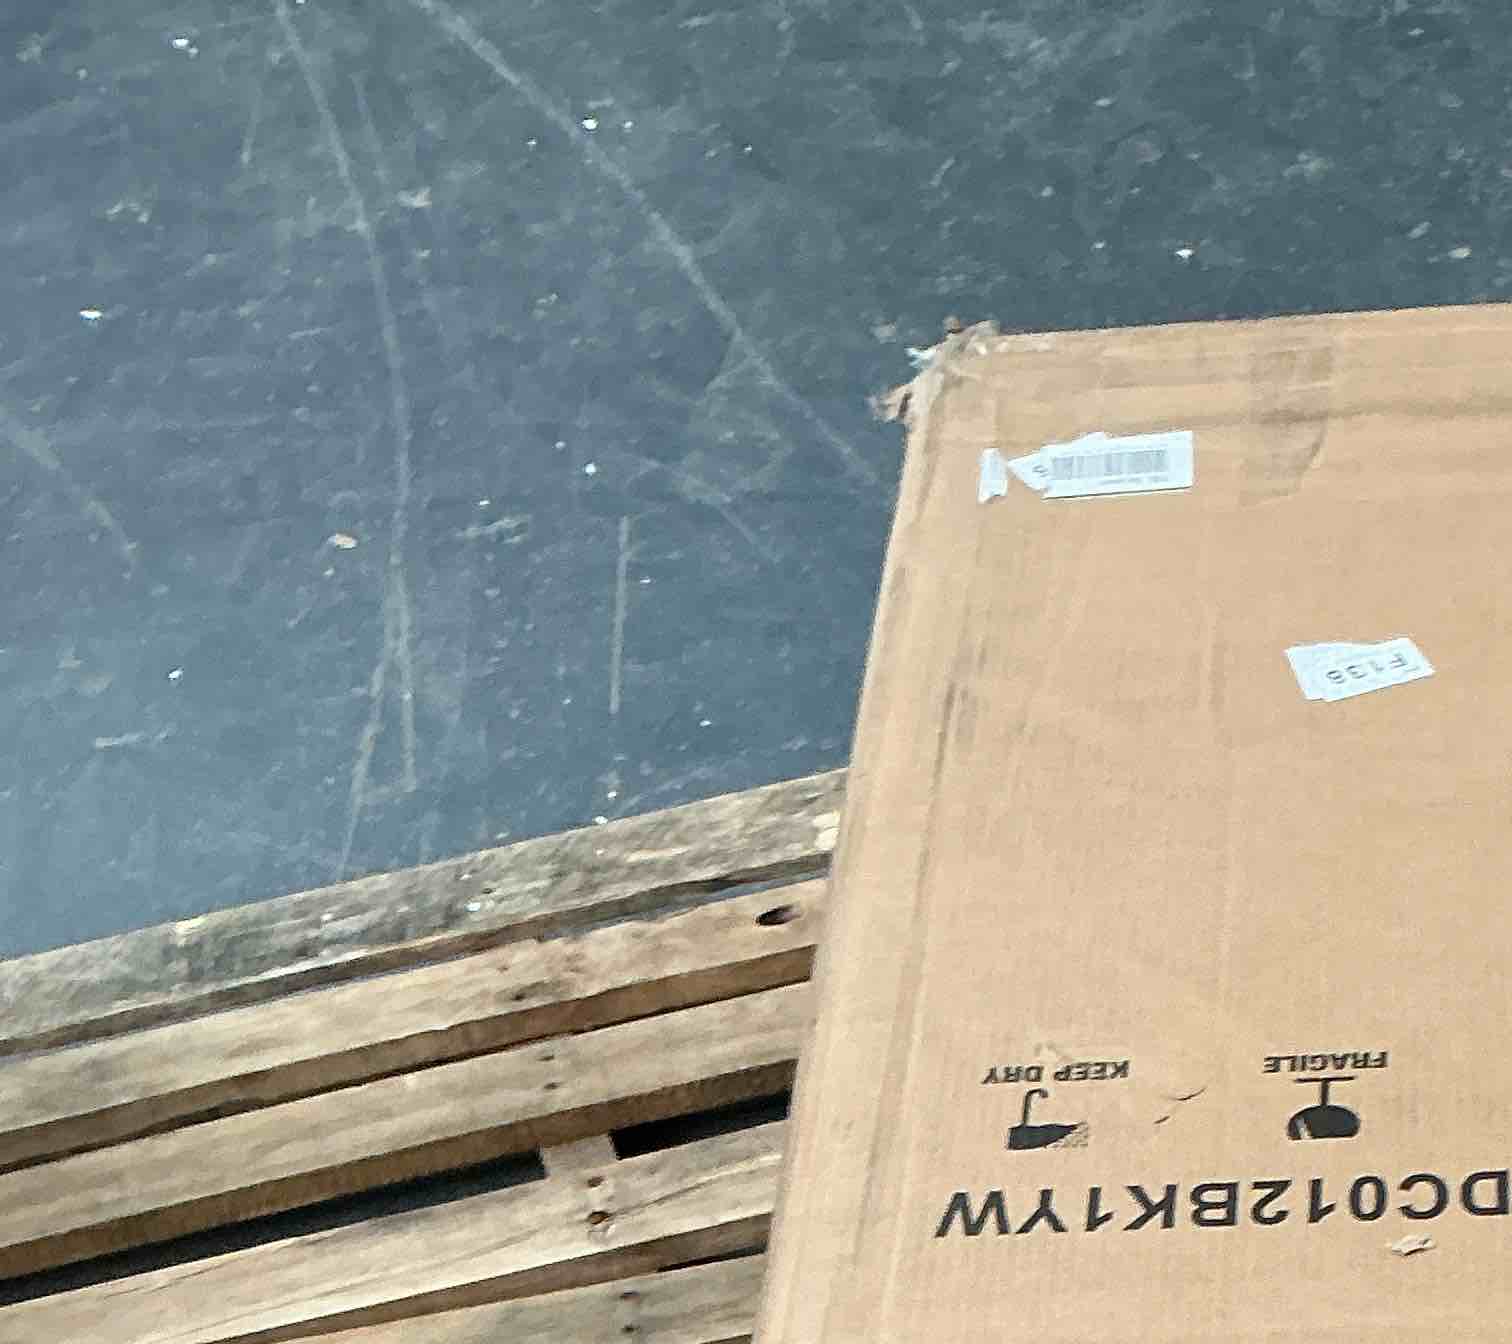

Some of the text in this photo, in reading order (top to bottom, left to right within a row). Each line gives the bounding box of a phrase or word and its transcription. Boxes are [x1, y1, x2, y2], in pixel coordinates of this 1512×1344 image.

[981, 1060, 1130, 1085] KEEP DRY
[1262, 1051, 1389, 1074] FRAGILE
